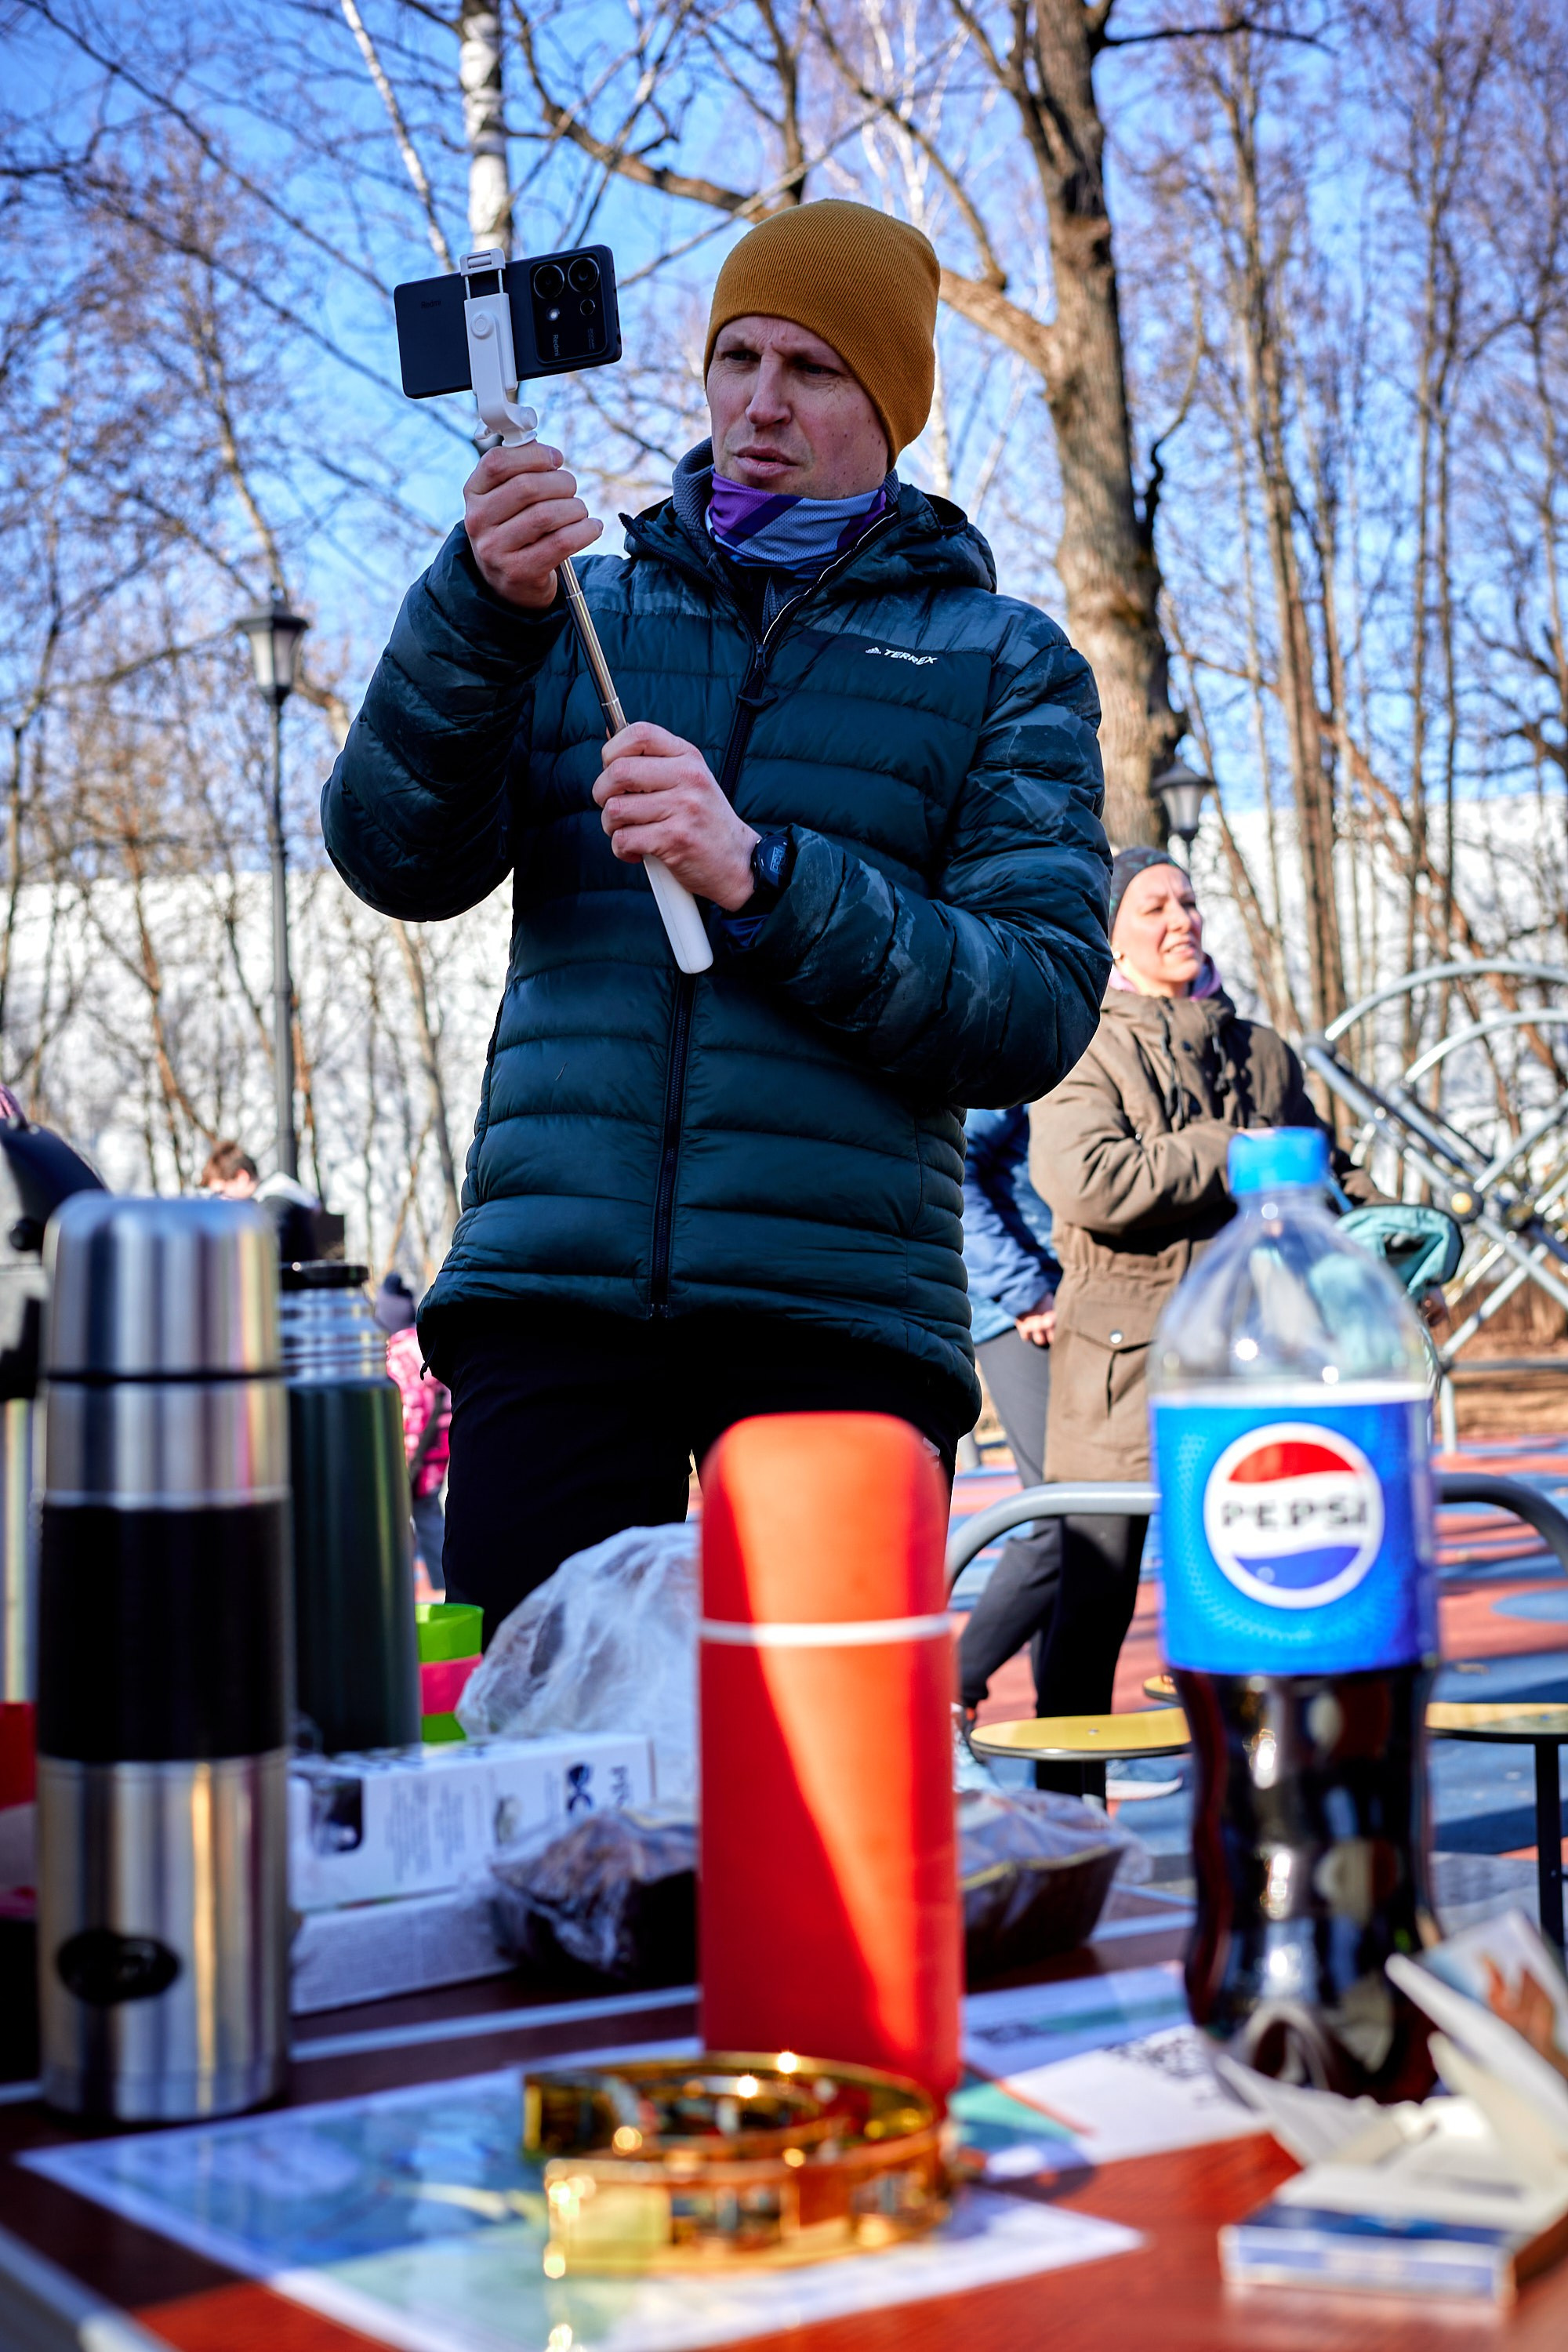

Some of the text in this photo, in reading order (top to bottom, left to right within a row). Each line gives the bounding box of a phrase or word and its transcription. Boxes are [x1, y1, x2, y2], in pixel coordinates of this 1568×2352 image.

[552, 334, 561, 356] Redmi
[884, 648, 938, 666] TERREX
[1221, 1494, 1369, 1530] PEPSI
